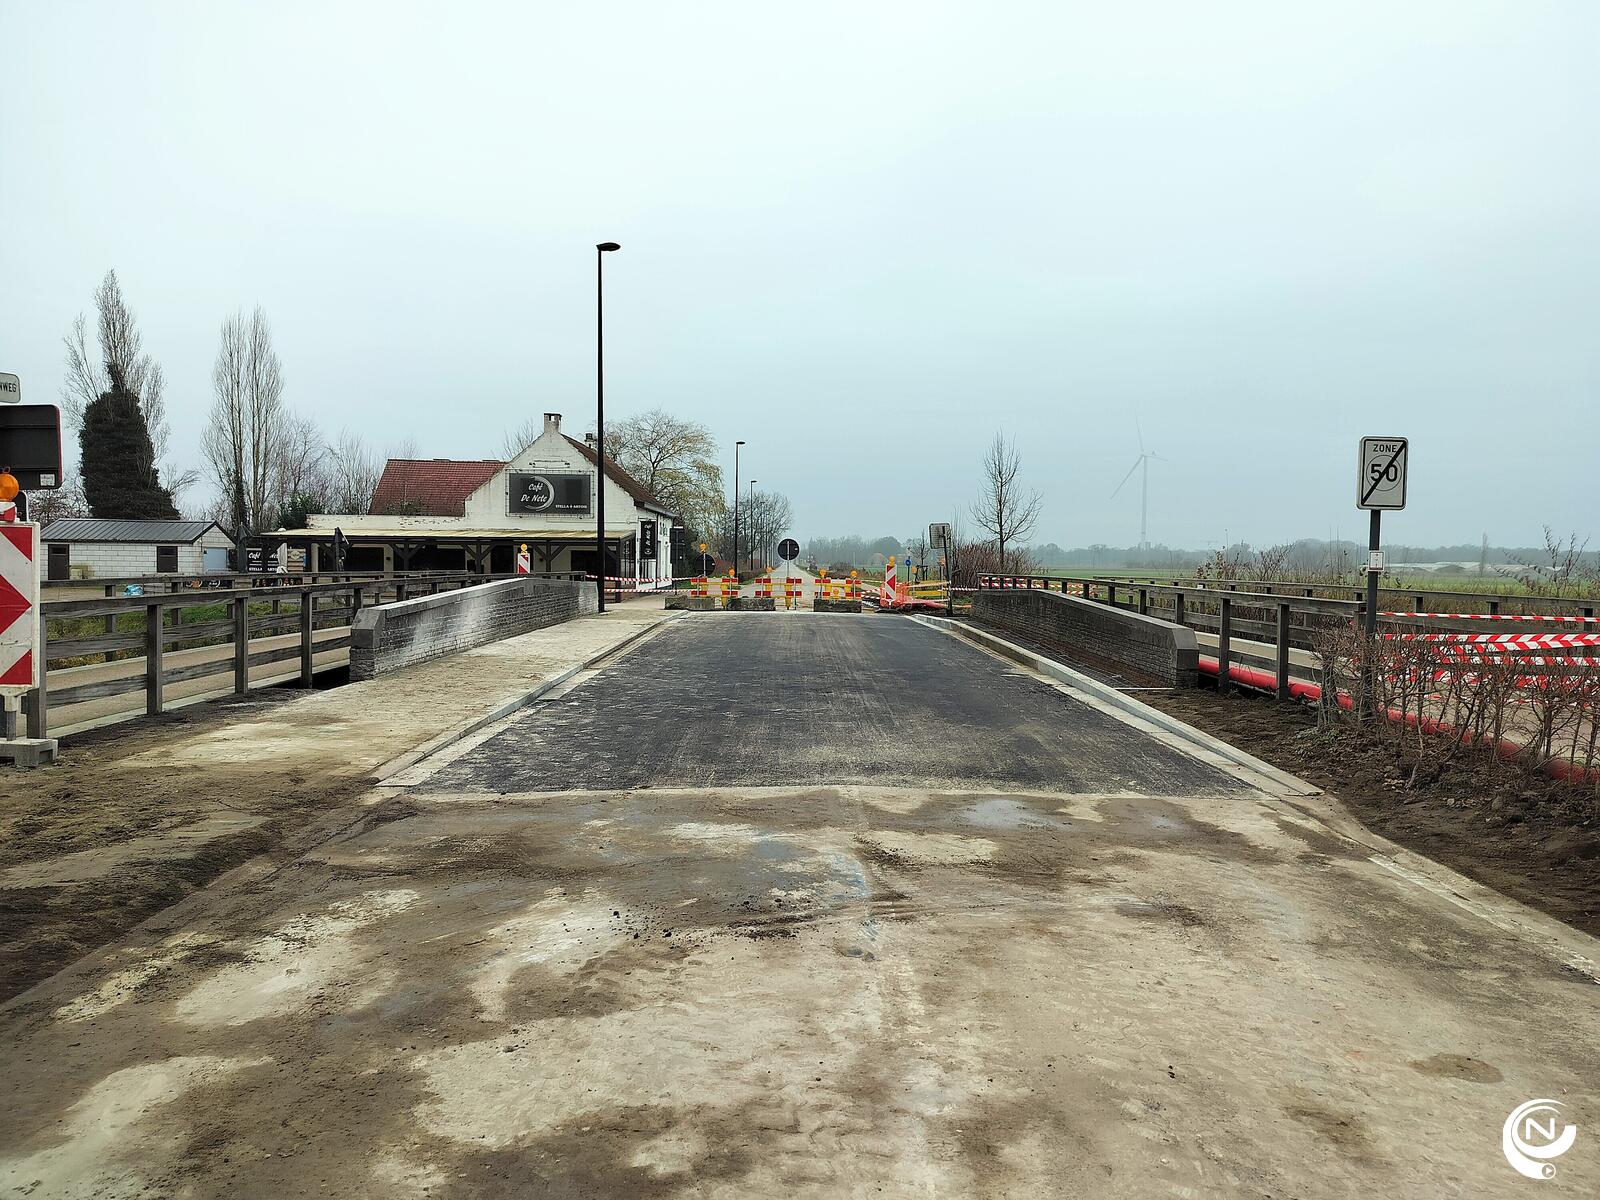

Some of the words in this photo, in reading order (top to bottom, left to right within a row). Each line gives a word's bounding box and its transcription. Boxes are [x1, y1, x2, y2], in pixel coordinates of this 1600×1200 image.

[1372, 444, 1398, 453] ZONE
[1370, 463, 1398, 482] 50
[528, 483, 543, 492] Café
[520, 494, 530, 502] De
[531, 494, 548, 503] Nete
